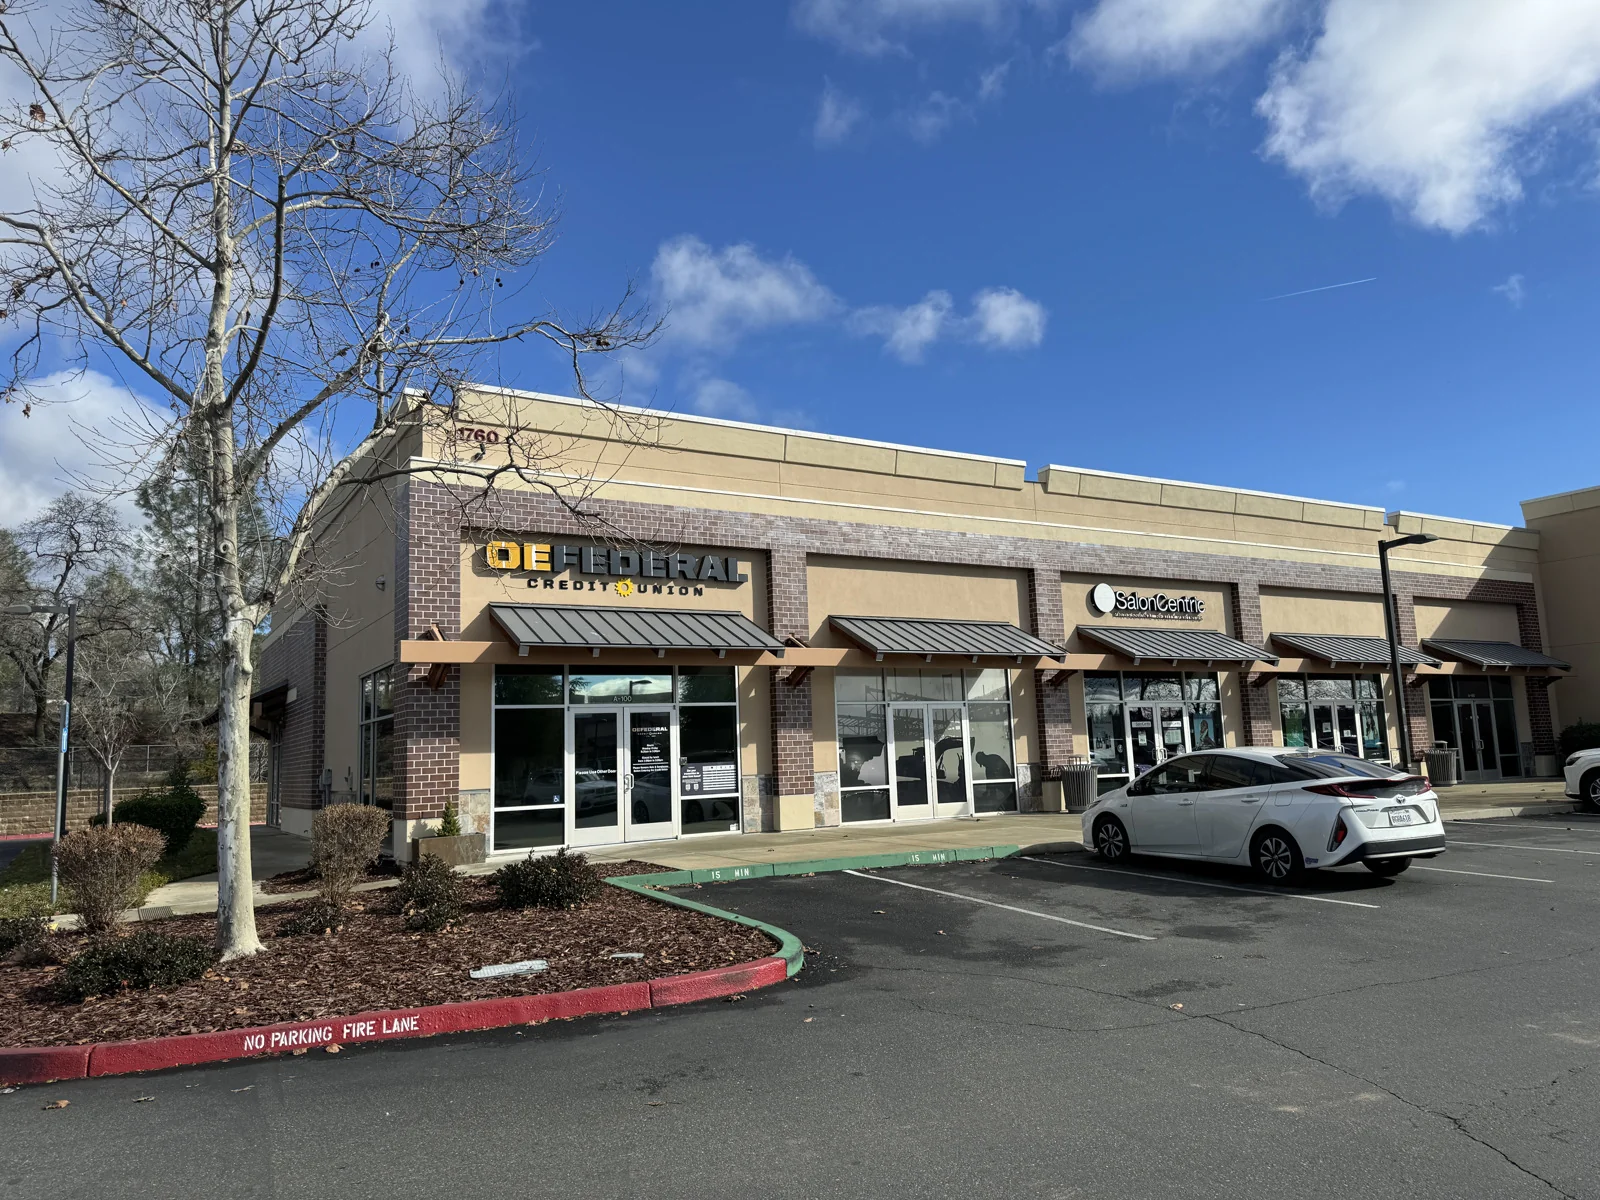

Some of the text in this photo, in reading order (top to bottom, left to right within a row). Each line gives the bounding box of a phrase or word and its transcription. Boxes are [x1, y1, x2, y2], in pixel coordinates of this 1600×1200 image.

[527, 578, 704, 597] CREDIT UNION
[1115, 590, 1206, 613] SalonCentric
[910, 852, 946, 863] 15 MIN
[711, 867, 750, 880] 15 MIN
[244, 1015, 420, 1051] NO PARKING FIRE LANE
